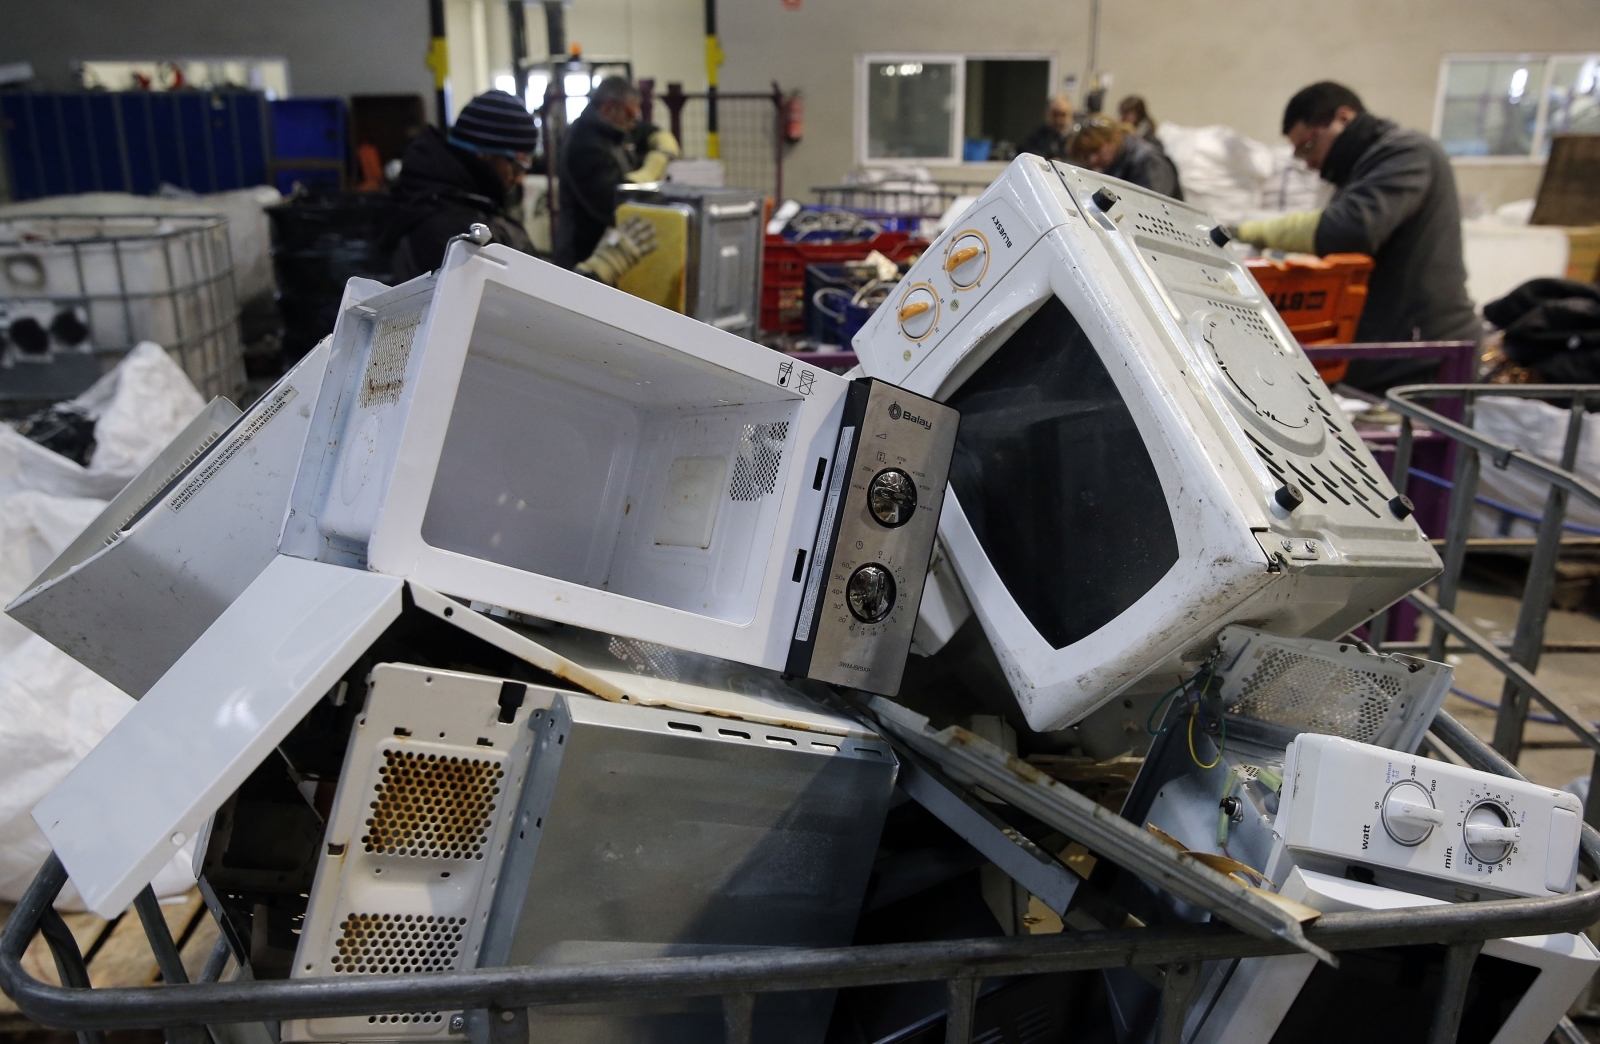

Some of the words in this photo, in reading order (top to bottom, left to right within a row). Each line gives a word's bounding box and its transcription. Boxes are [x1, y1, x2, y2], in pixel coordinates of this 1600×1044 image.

[991, 215, 1013, 248] BLUESKY
[251, 420, 265, 435] TIRAR
[262, 412, 274, 424] ESTA
[272, 399, 287, 415] TAMPA
[903, 411, 932, 430] Balay
[217, 433, 245, 461] MICROONDAS
[250, 409, 269, 428] RETIRAR
[1362, 824, 1370, 850] watt
[1444, 846, 1452, 869] min.
[1468, 856, 1473, 865] 60
[1507, 857, 1512, 865] 20
[1478, 864, 1482, 872] 50
[1488, 866, 1493, 874] 40
[1498, 864, 1503, 872] 30
